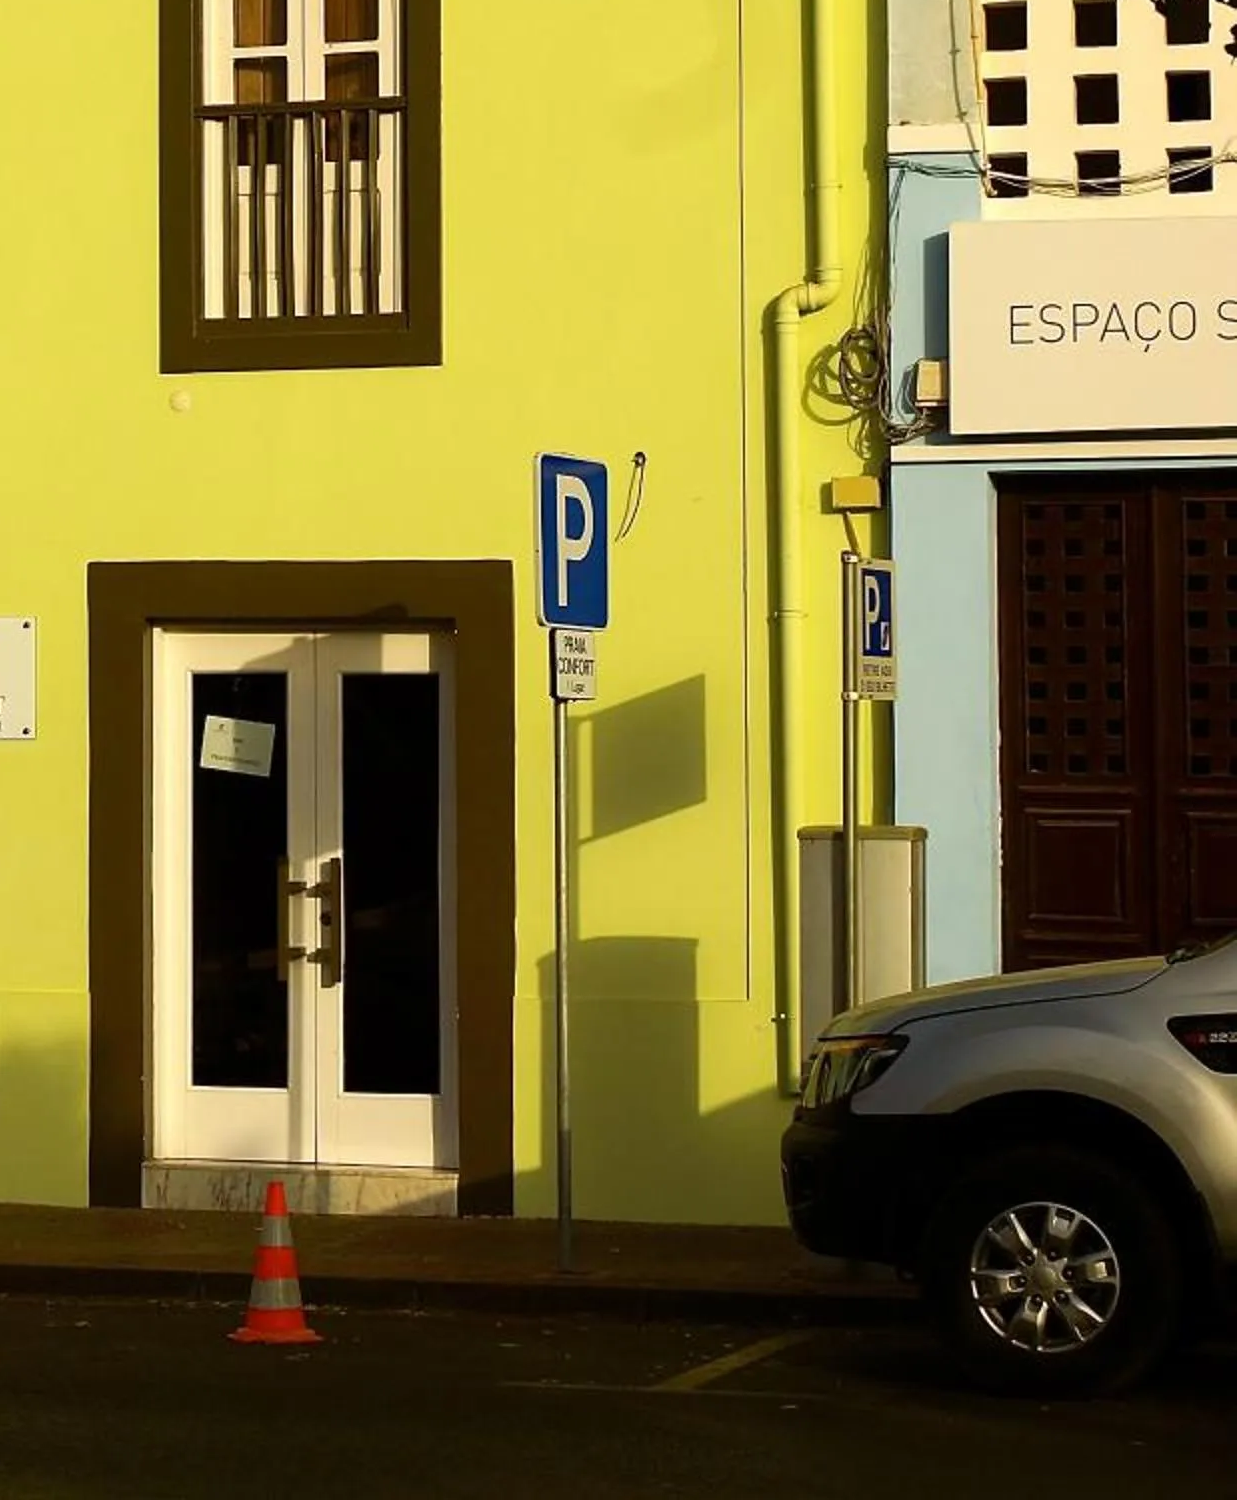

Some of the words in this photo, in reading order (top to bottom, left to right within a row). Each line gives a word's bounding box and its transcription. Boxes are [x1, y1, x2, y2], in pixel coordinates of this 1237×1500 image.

[1009, 301, 1197, 353] ESPAÇO
[555, 473, 595, 607] P
[864, 575, 881, 651] P
[557, 656, 595, 676] CONFORT
[563, 634, 587, 654] PRAIA
